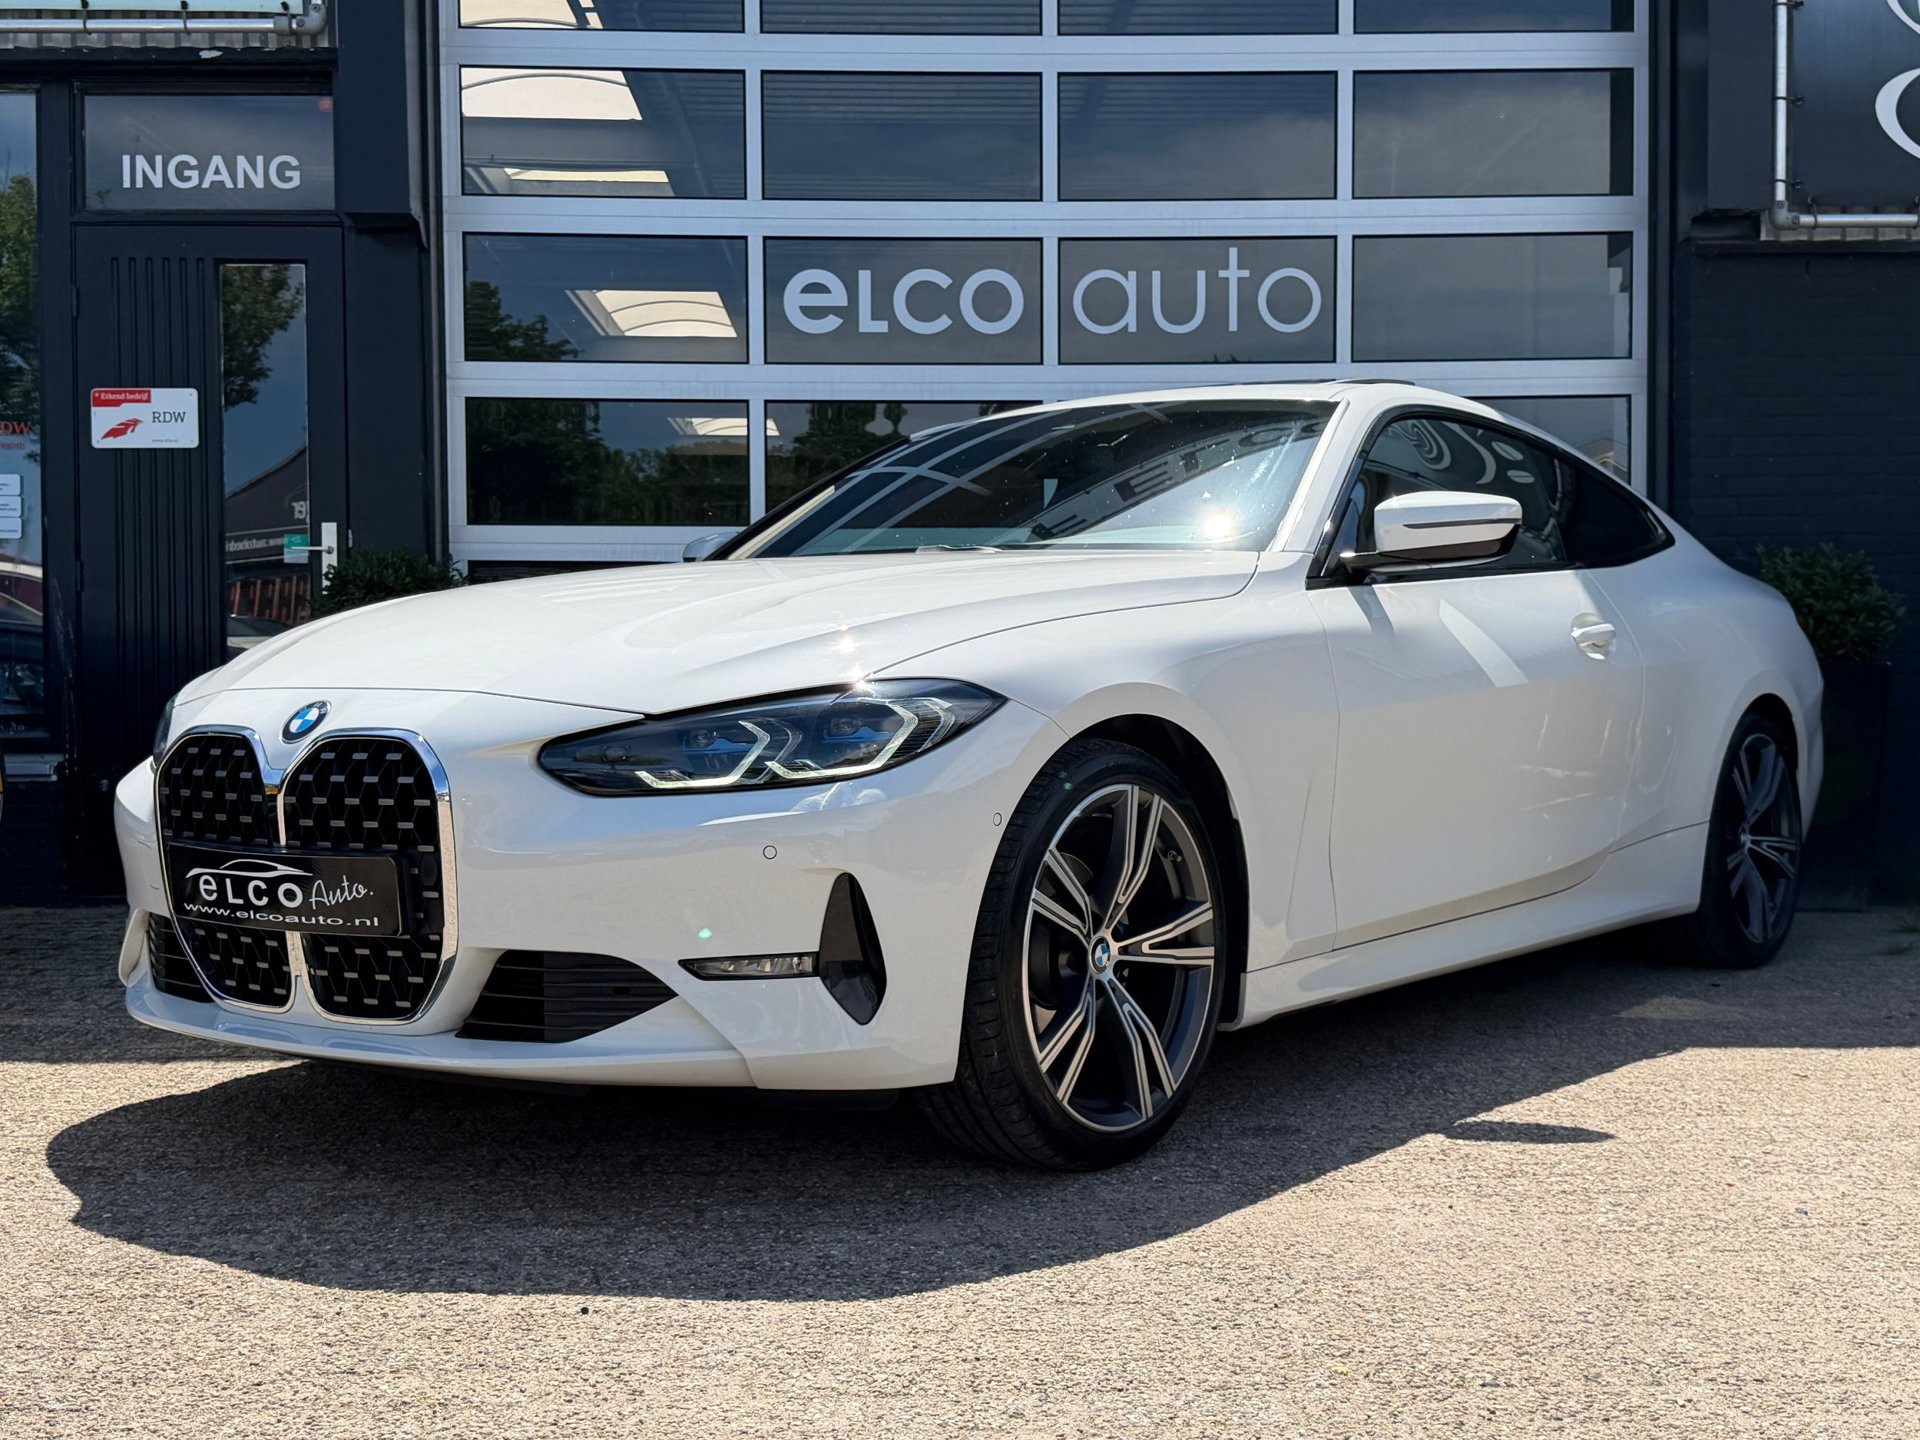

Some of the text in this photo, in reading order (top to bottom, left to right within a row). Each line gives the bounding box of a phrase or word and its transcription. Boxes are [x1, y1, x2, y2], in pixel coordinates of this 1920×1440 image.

[122, 154, 302, 190] INGANG
[1072, 246, 1323, 335] auto
[100, 392, 149, 401] Erkend bedrijf
[151, 411, 187, 424] RDW
[183, 902, 379, 928] www.elcoauto.nl
